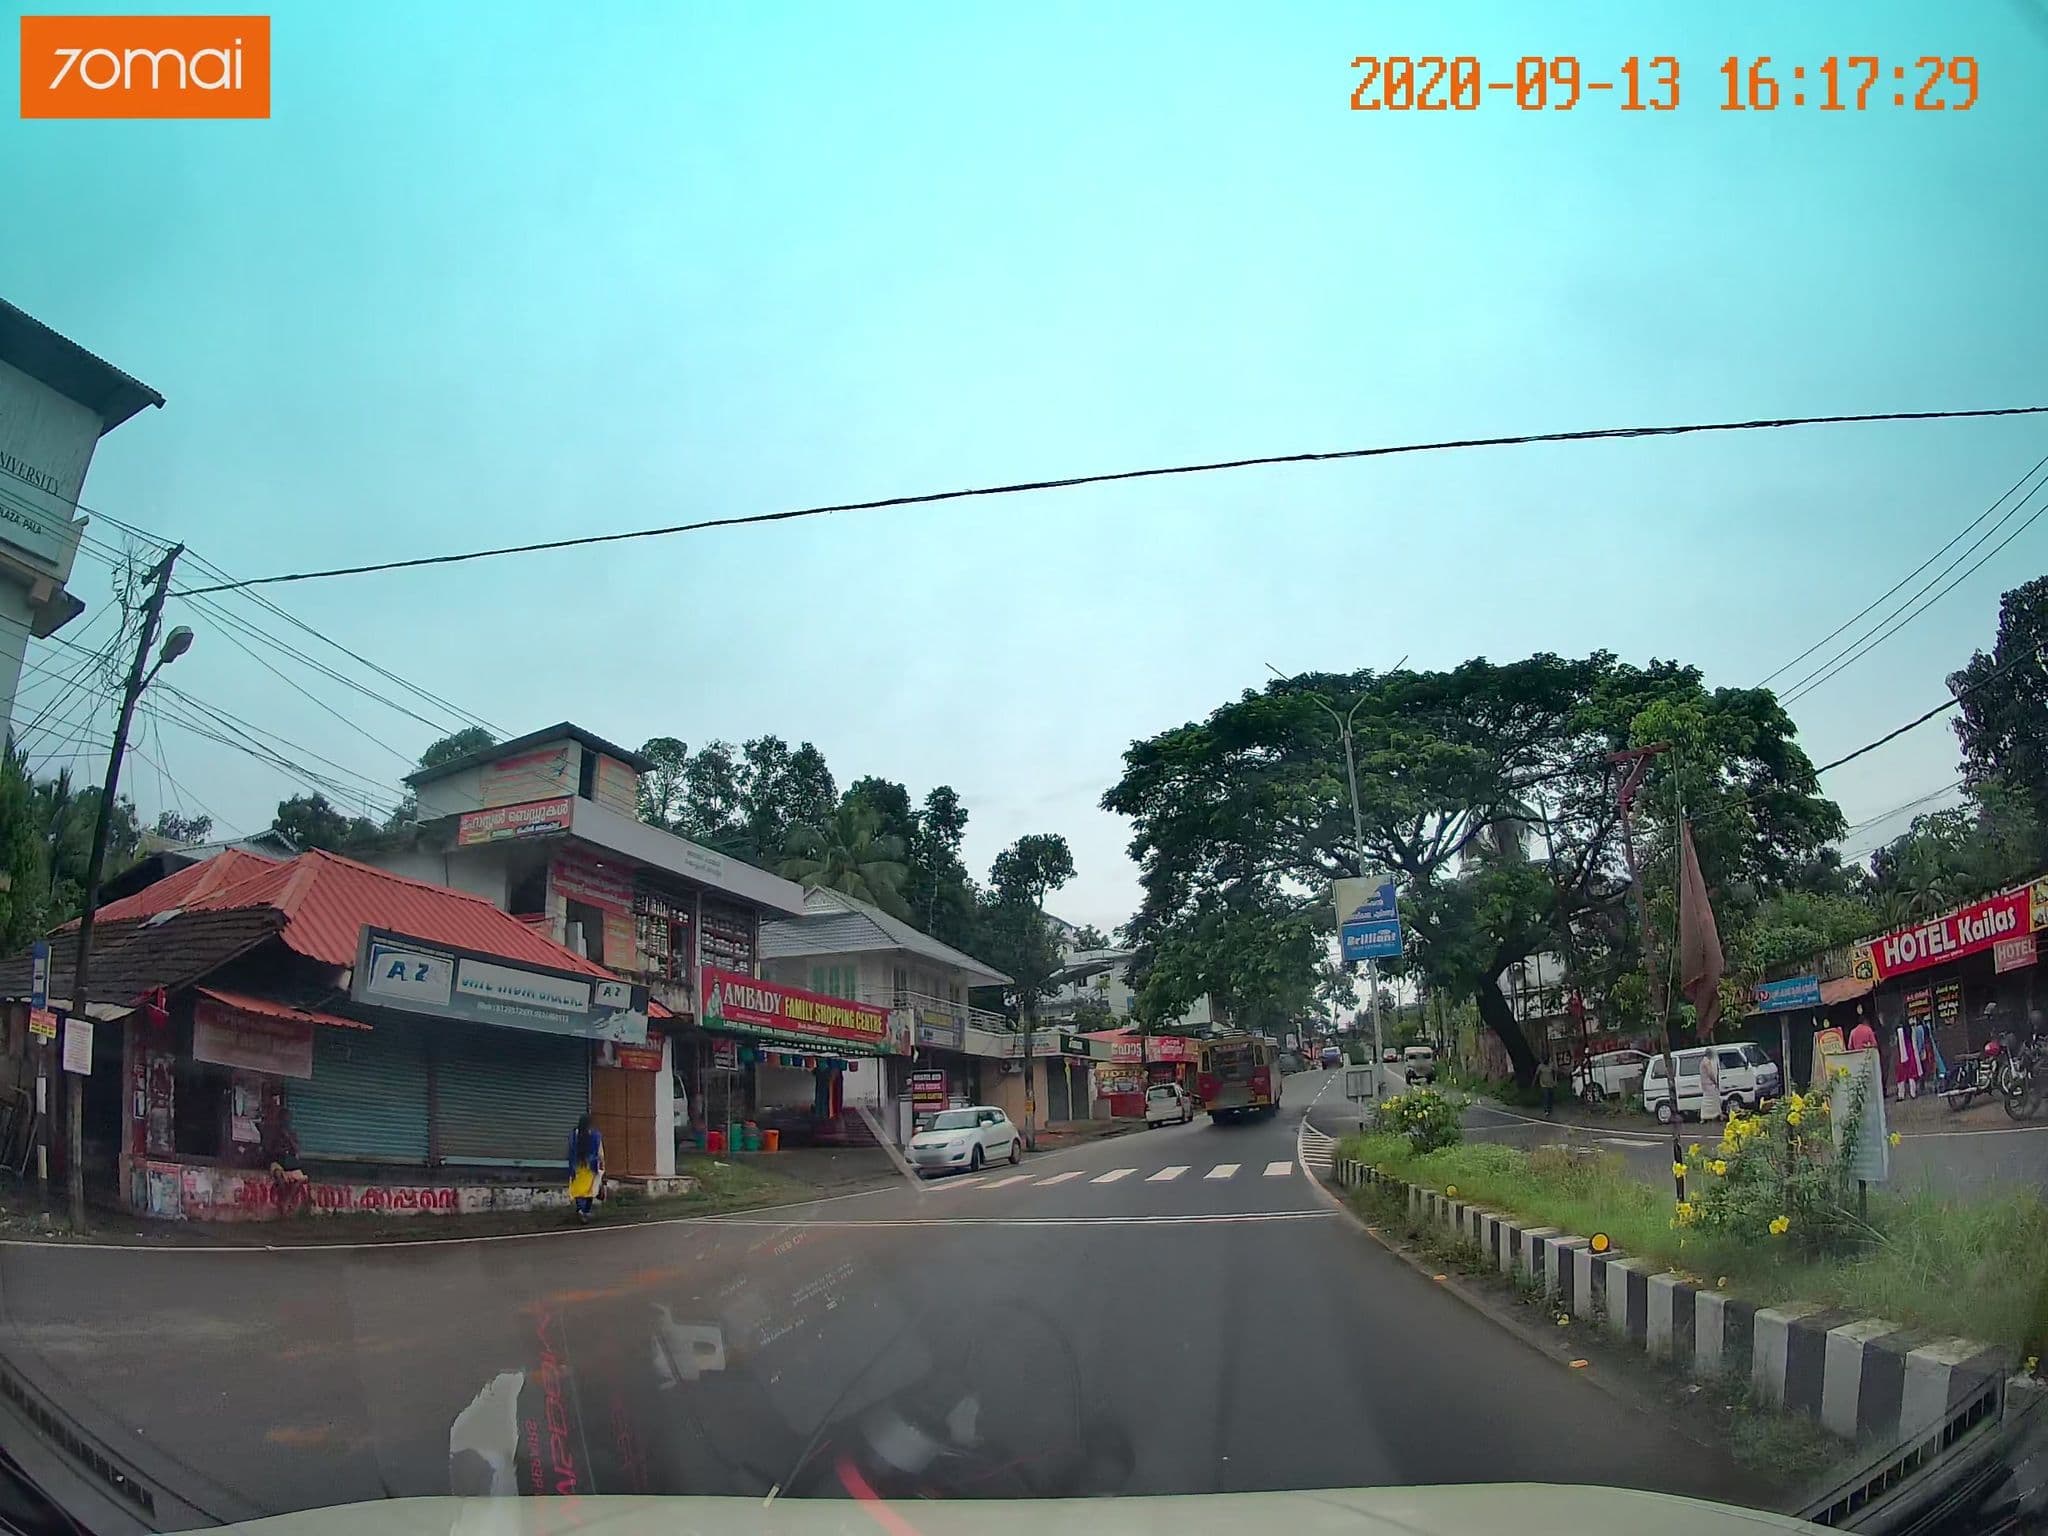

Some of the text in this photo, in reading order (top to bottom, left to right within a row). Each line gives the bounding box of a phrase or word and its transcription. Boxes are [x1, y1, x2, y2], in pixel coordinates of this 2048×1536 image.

[0, 450, 58, 496] NIVERSITY
[0, 506, 20, 523] LAZA
[1882, 905, 2016, 968] HOTEL Kailas
[1998, 938, 2036, 961] HOTEL
[723, 982, 783, 1015] AMBADY
[784, 996, 814, 1022] FAMILY
[815, 1002, 855, 1028] SHOPPING
[855, 1009, 883, 1034] CENTRE
